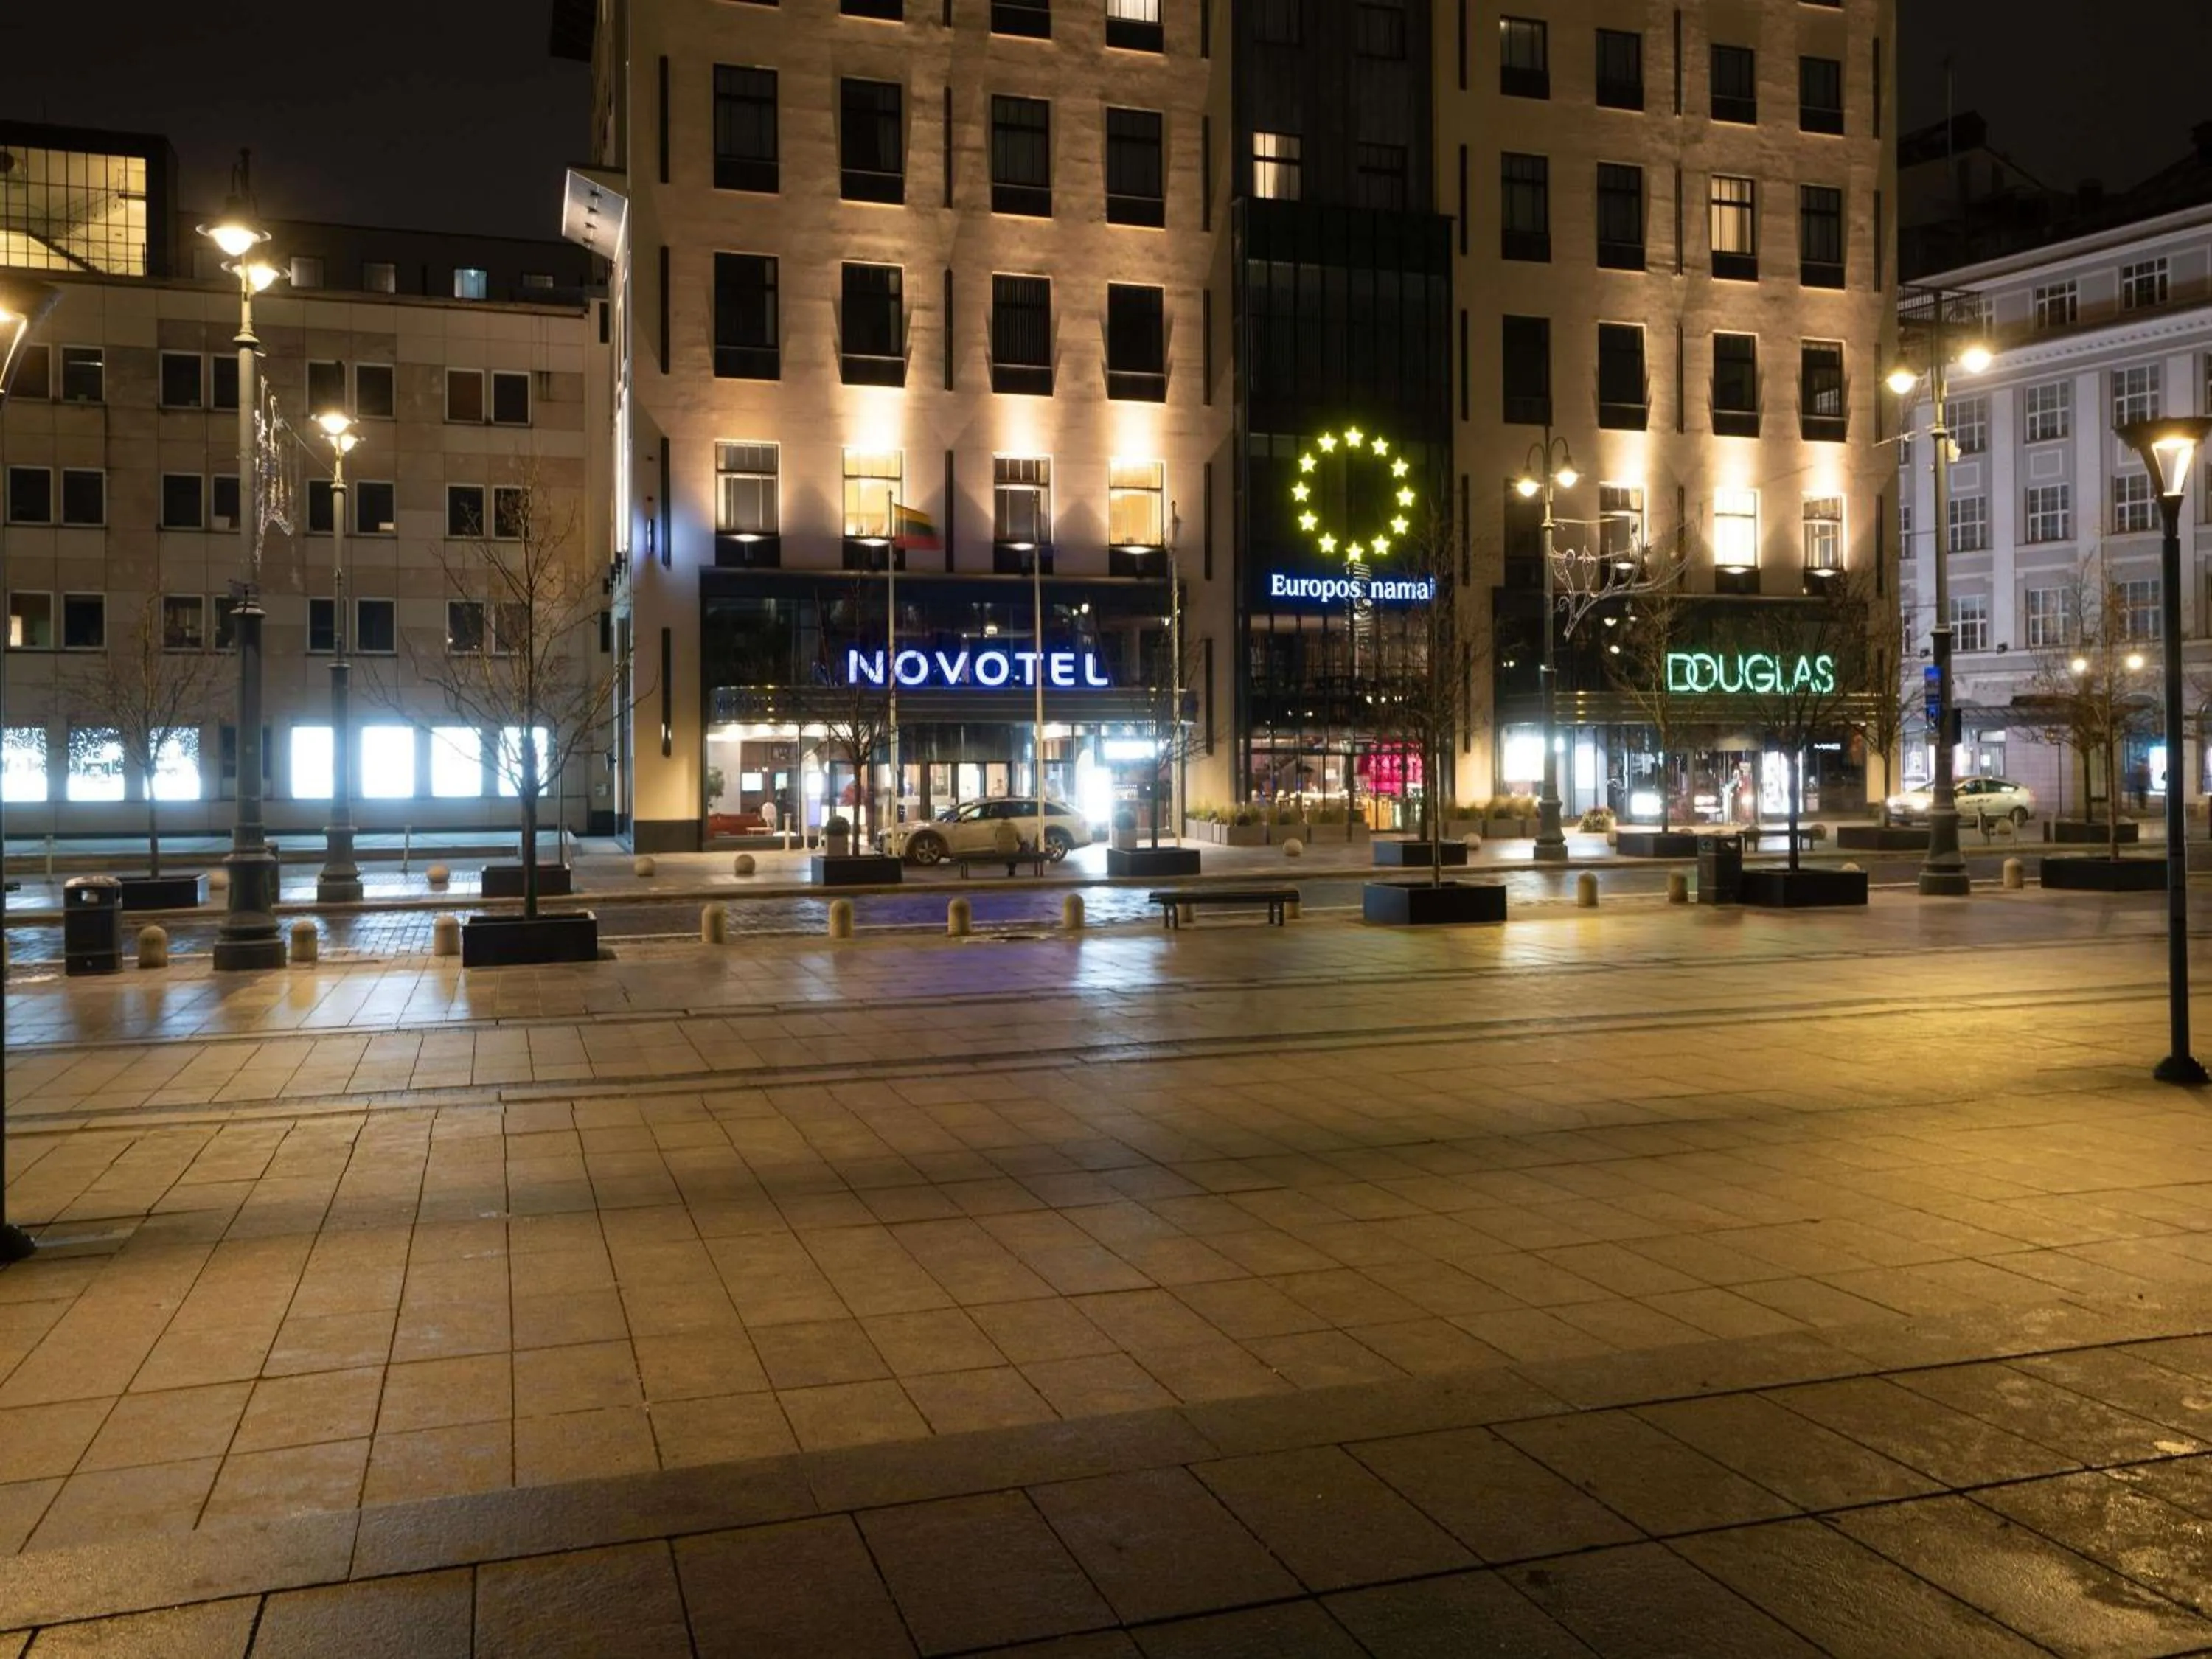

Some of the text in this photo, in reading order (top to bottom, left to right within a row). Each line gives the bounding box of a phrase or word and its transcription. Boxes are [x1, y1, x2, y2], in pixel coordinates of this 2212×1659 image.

[1270, 574, 1361, 602] Europos
[848, 649, 1109, 686] NOVOTEL
[1666, 653, 1835, 694] DOUGLAS
